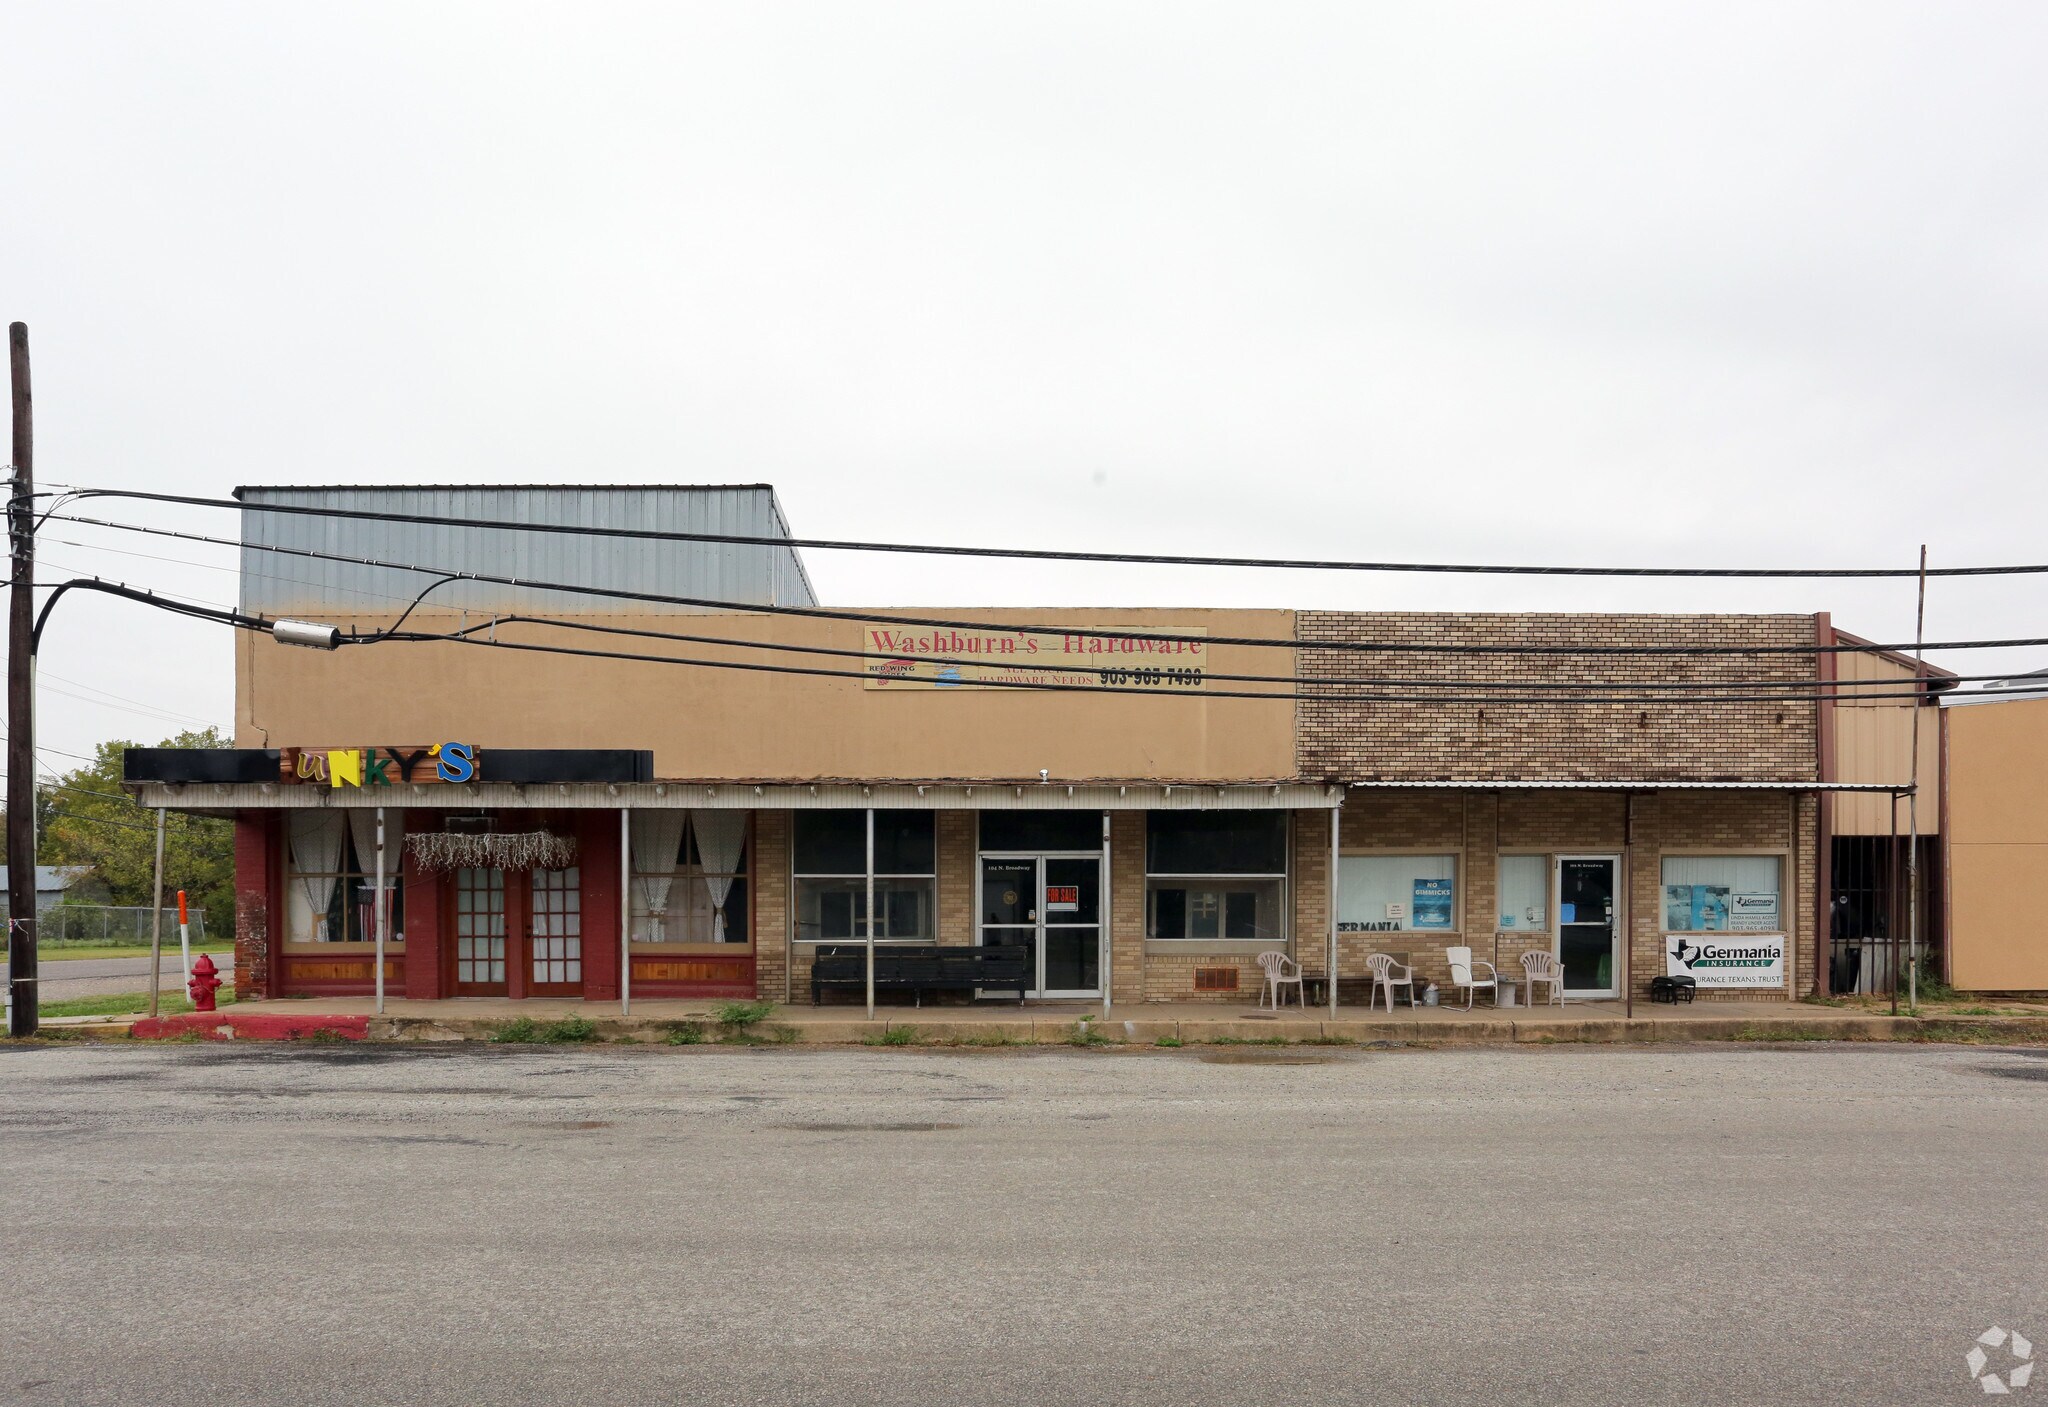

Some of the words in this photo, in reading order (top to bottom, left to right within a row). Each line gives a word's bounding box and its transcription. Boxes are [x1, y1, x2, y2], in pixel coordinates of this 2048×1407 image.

[870, 631, 1038, 654] Washburn's
[1063, 633, 1202, 655] Hardware
[1052, 674, 1093, 685] NEEDS
[1047, 888, 1060, 902] FOR
[1060, 888, 1077, 902] SALE
[1703, 945, 1781, 959] Germania
[1758, 975, 1781, 983] TRUST
